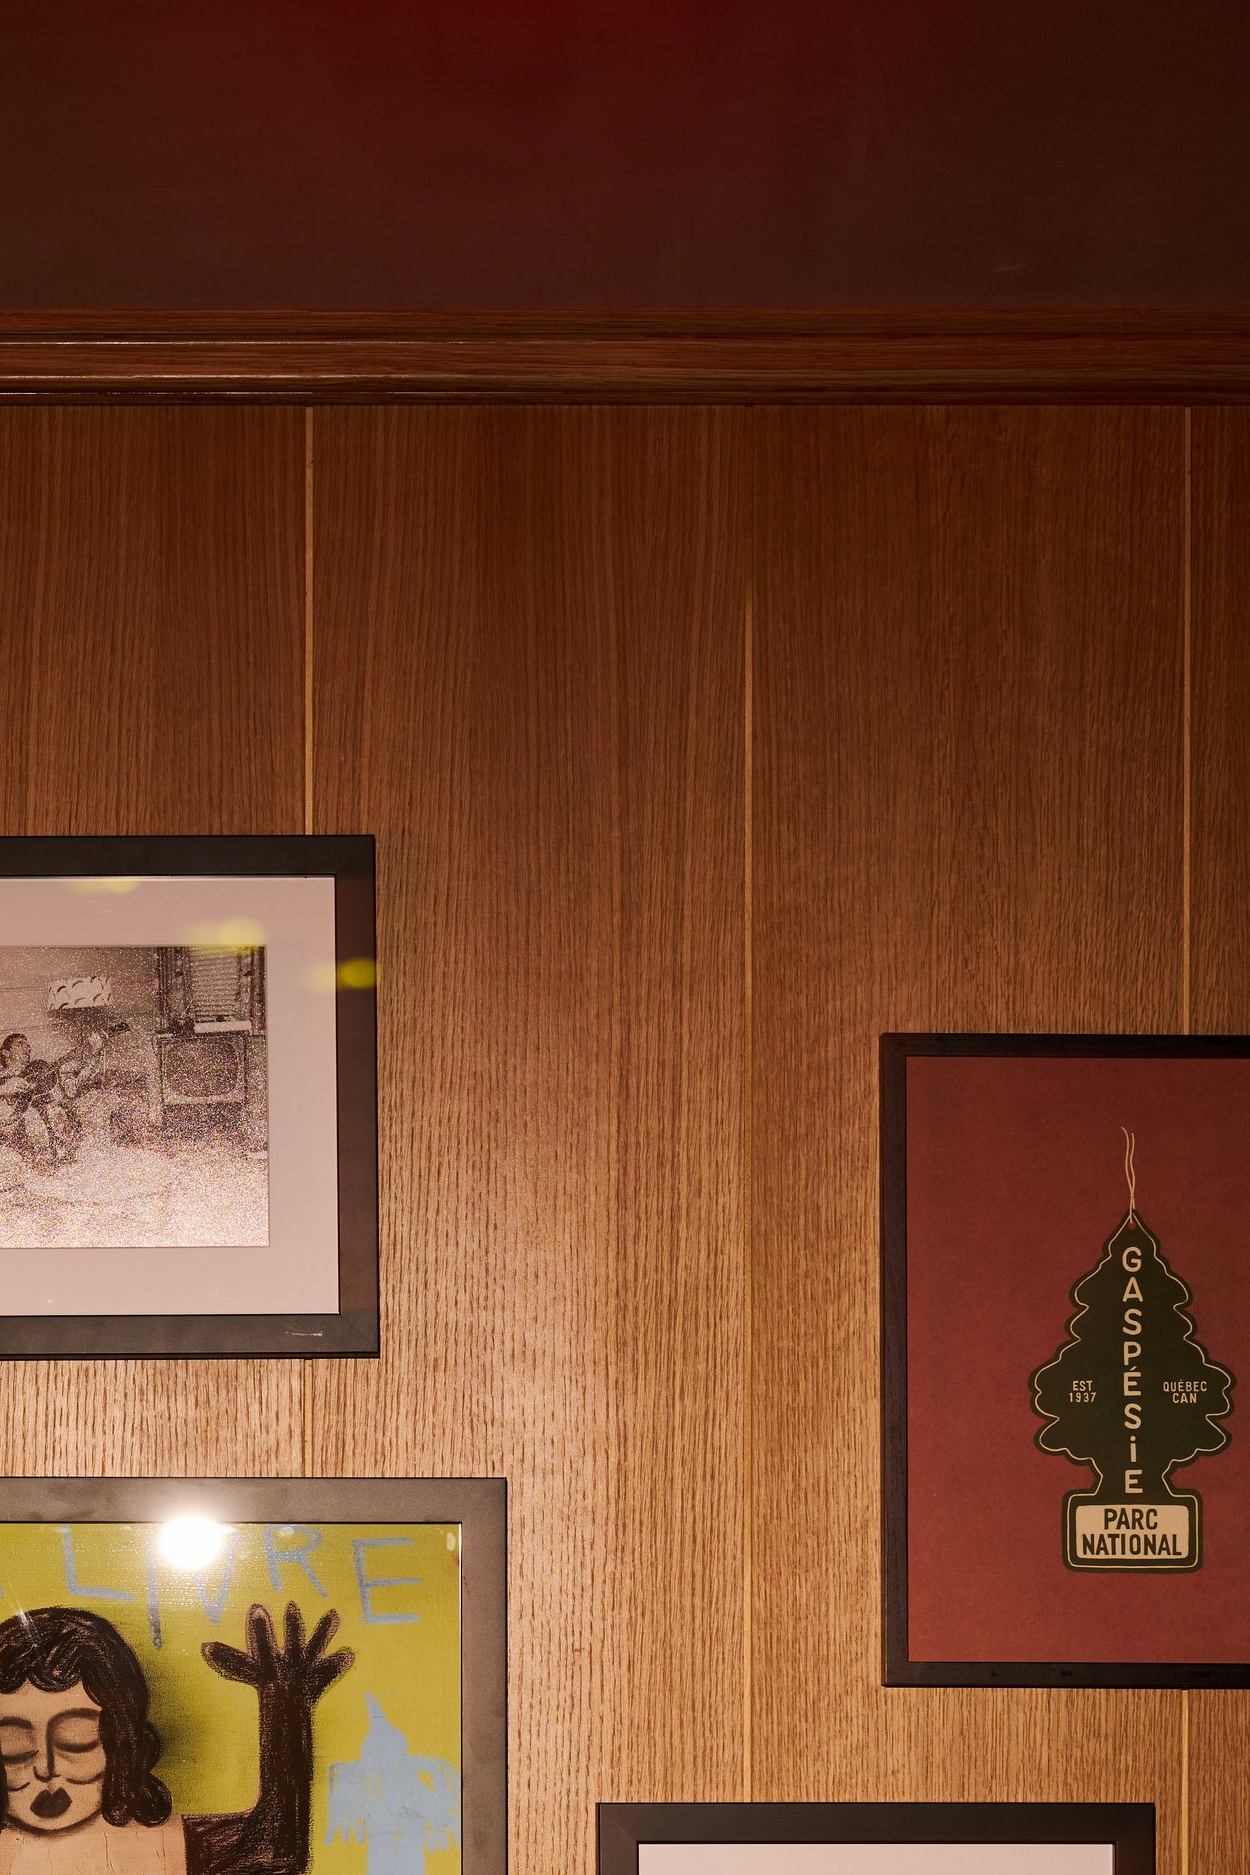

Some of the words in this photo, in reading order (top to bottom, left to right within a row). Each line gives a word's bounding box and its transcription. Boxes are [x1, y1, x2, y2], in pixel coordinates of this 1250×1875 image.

[1072, 1380, 1093, 1391] EST
[1163, 1378, 1207, 1393] QUÉBEC
[1069, 1392, 1097, 1403] 1937
[1172, 1392, 1197, 1404] CAN
[1103, 1508, 1158, 1530] PARC
[1082, 1533, 1182, 1556] NATIONAL
